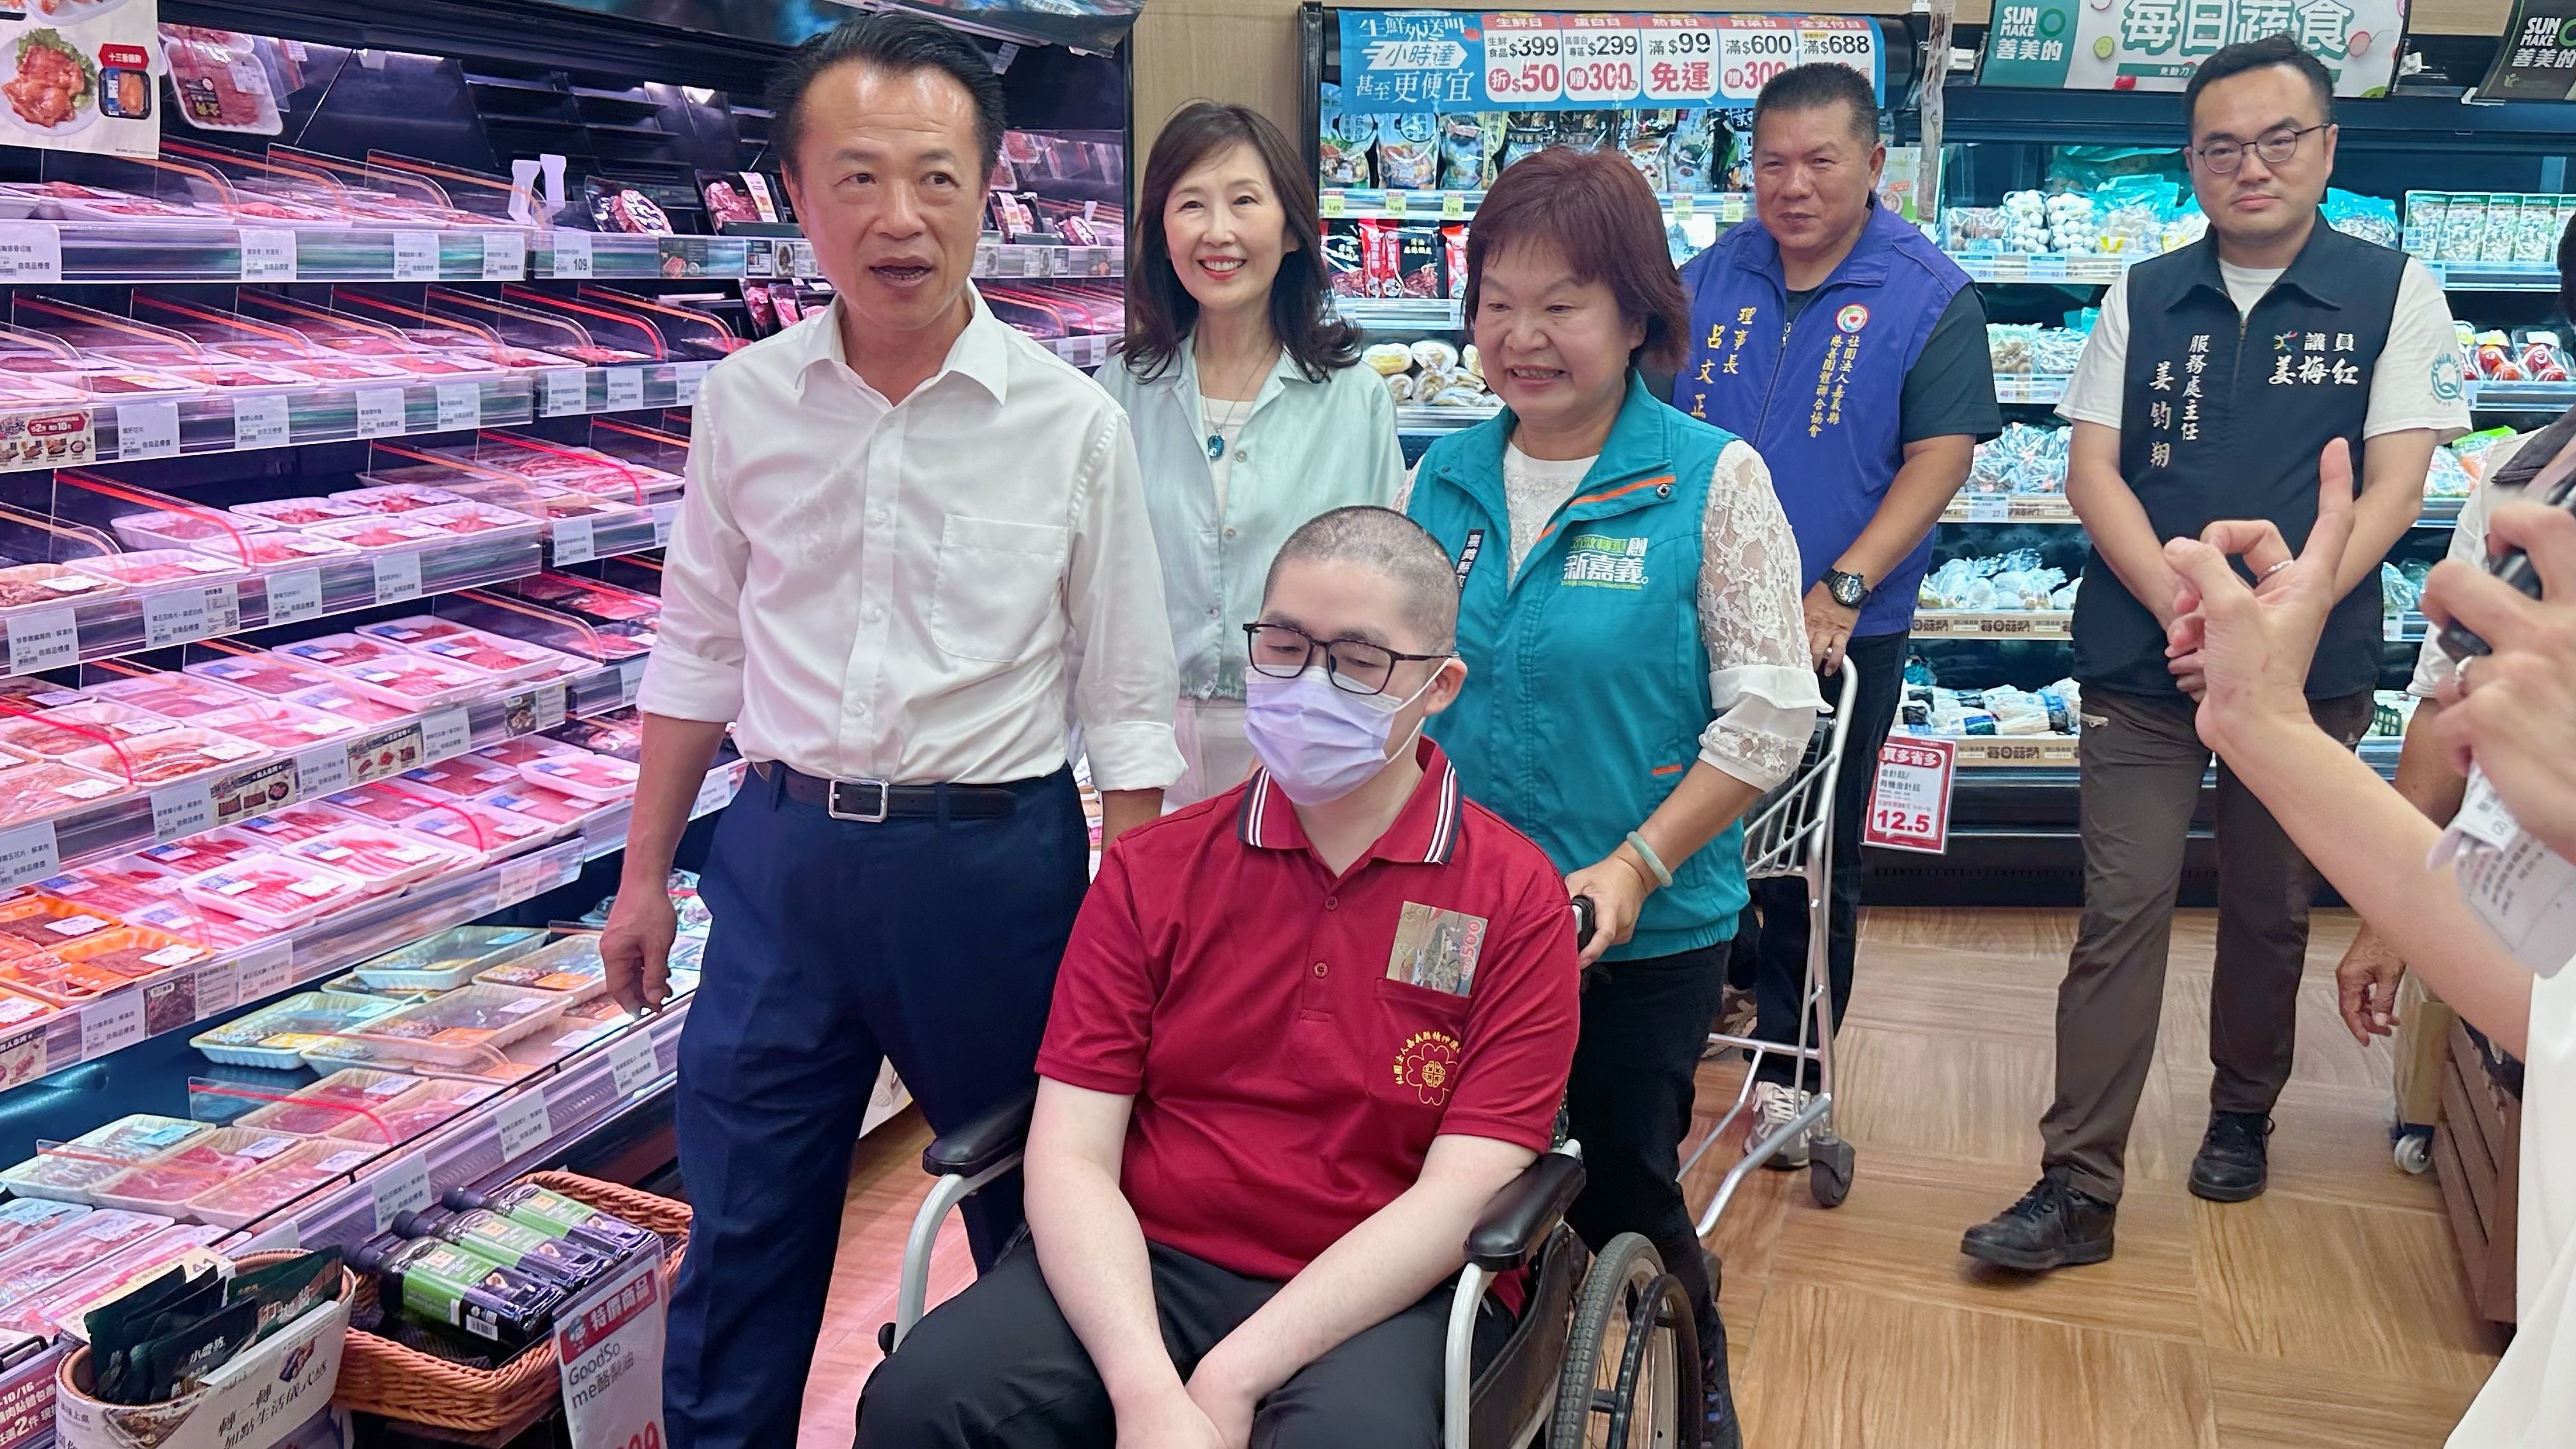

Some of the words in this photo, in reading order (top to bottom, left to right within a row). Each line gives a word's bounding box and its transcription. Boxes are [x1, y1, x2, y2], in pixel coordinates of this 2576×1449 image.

[1496, 18, 1544, 27] 生鮮日
[1574, 18, 1621, 27] 蛋白日
[1652, 18, 1698, 27] 熟食日
[1799, 20, 1861, 29] 全支付日
[2002, 6, 2038, 25] SUN
[2524, 17, 2561, 34] SUN
[1999, 24, 2036, 37] MAKE
[1509, 35, 1559, 58] $399
[1588, 35, 1638, 57] $299
[1669, 33, 1711, 56] $99
[1996, 38, 2064, 61] 善美的
[2520, 35, 2556, 47] MAKE
[1384, 43, 1456, 67] 小時達
[1489, 47, 1508, 58] 食品
[2511, 49, 2576, 68] 善美的
[1356, 70, 1475, 103] 甚至更便宜
[1512, 63, 1560, 93] $50
[1651, 62, 1711, 93] 免運
[574, 258, 588, 271] 109
[1722, 306, 1758, 375] 理事長
[2303, 332, 2354, 352] 議員
[1690, 324, 1726, 419] 呂文正
[2181, 334, 2211, 441] 服務處主任
[1625, 537, 1648, 556] 創
[1883, 747, 1938, 766] 買多省多
[1877, 809, 1930, 833] 12.5
[569, 1341, 620, 1387] GoodSo
